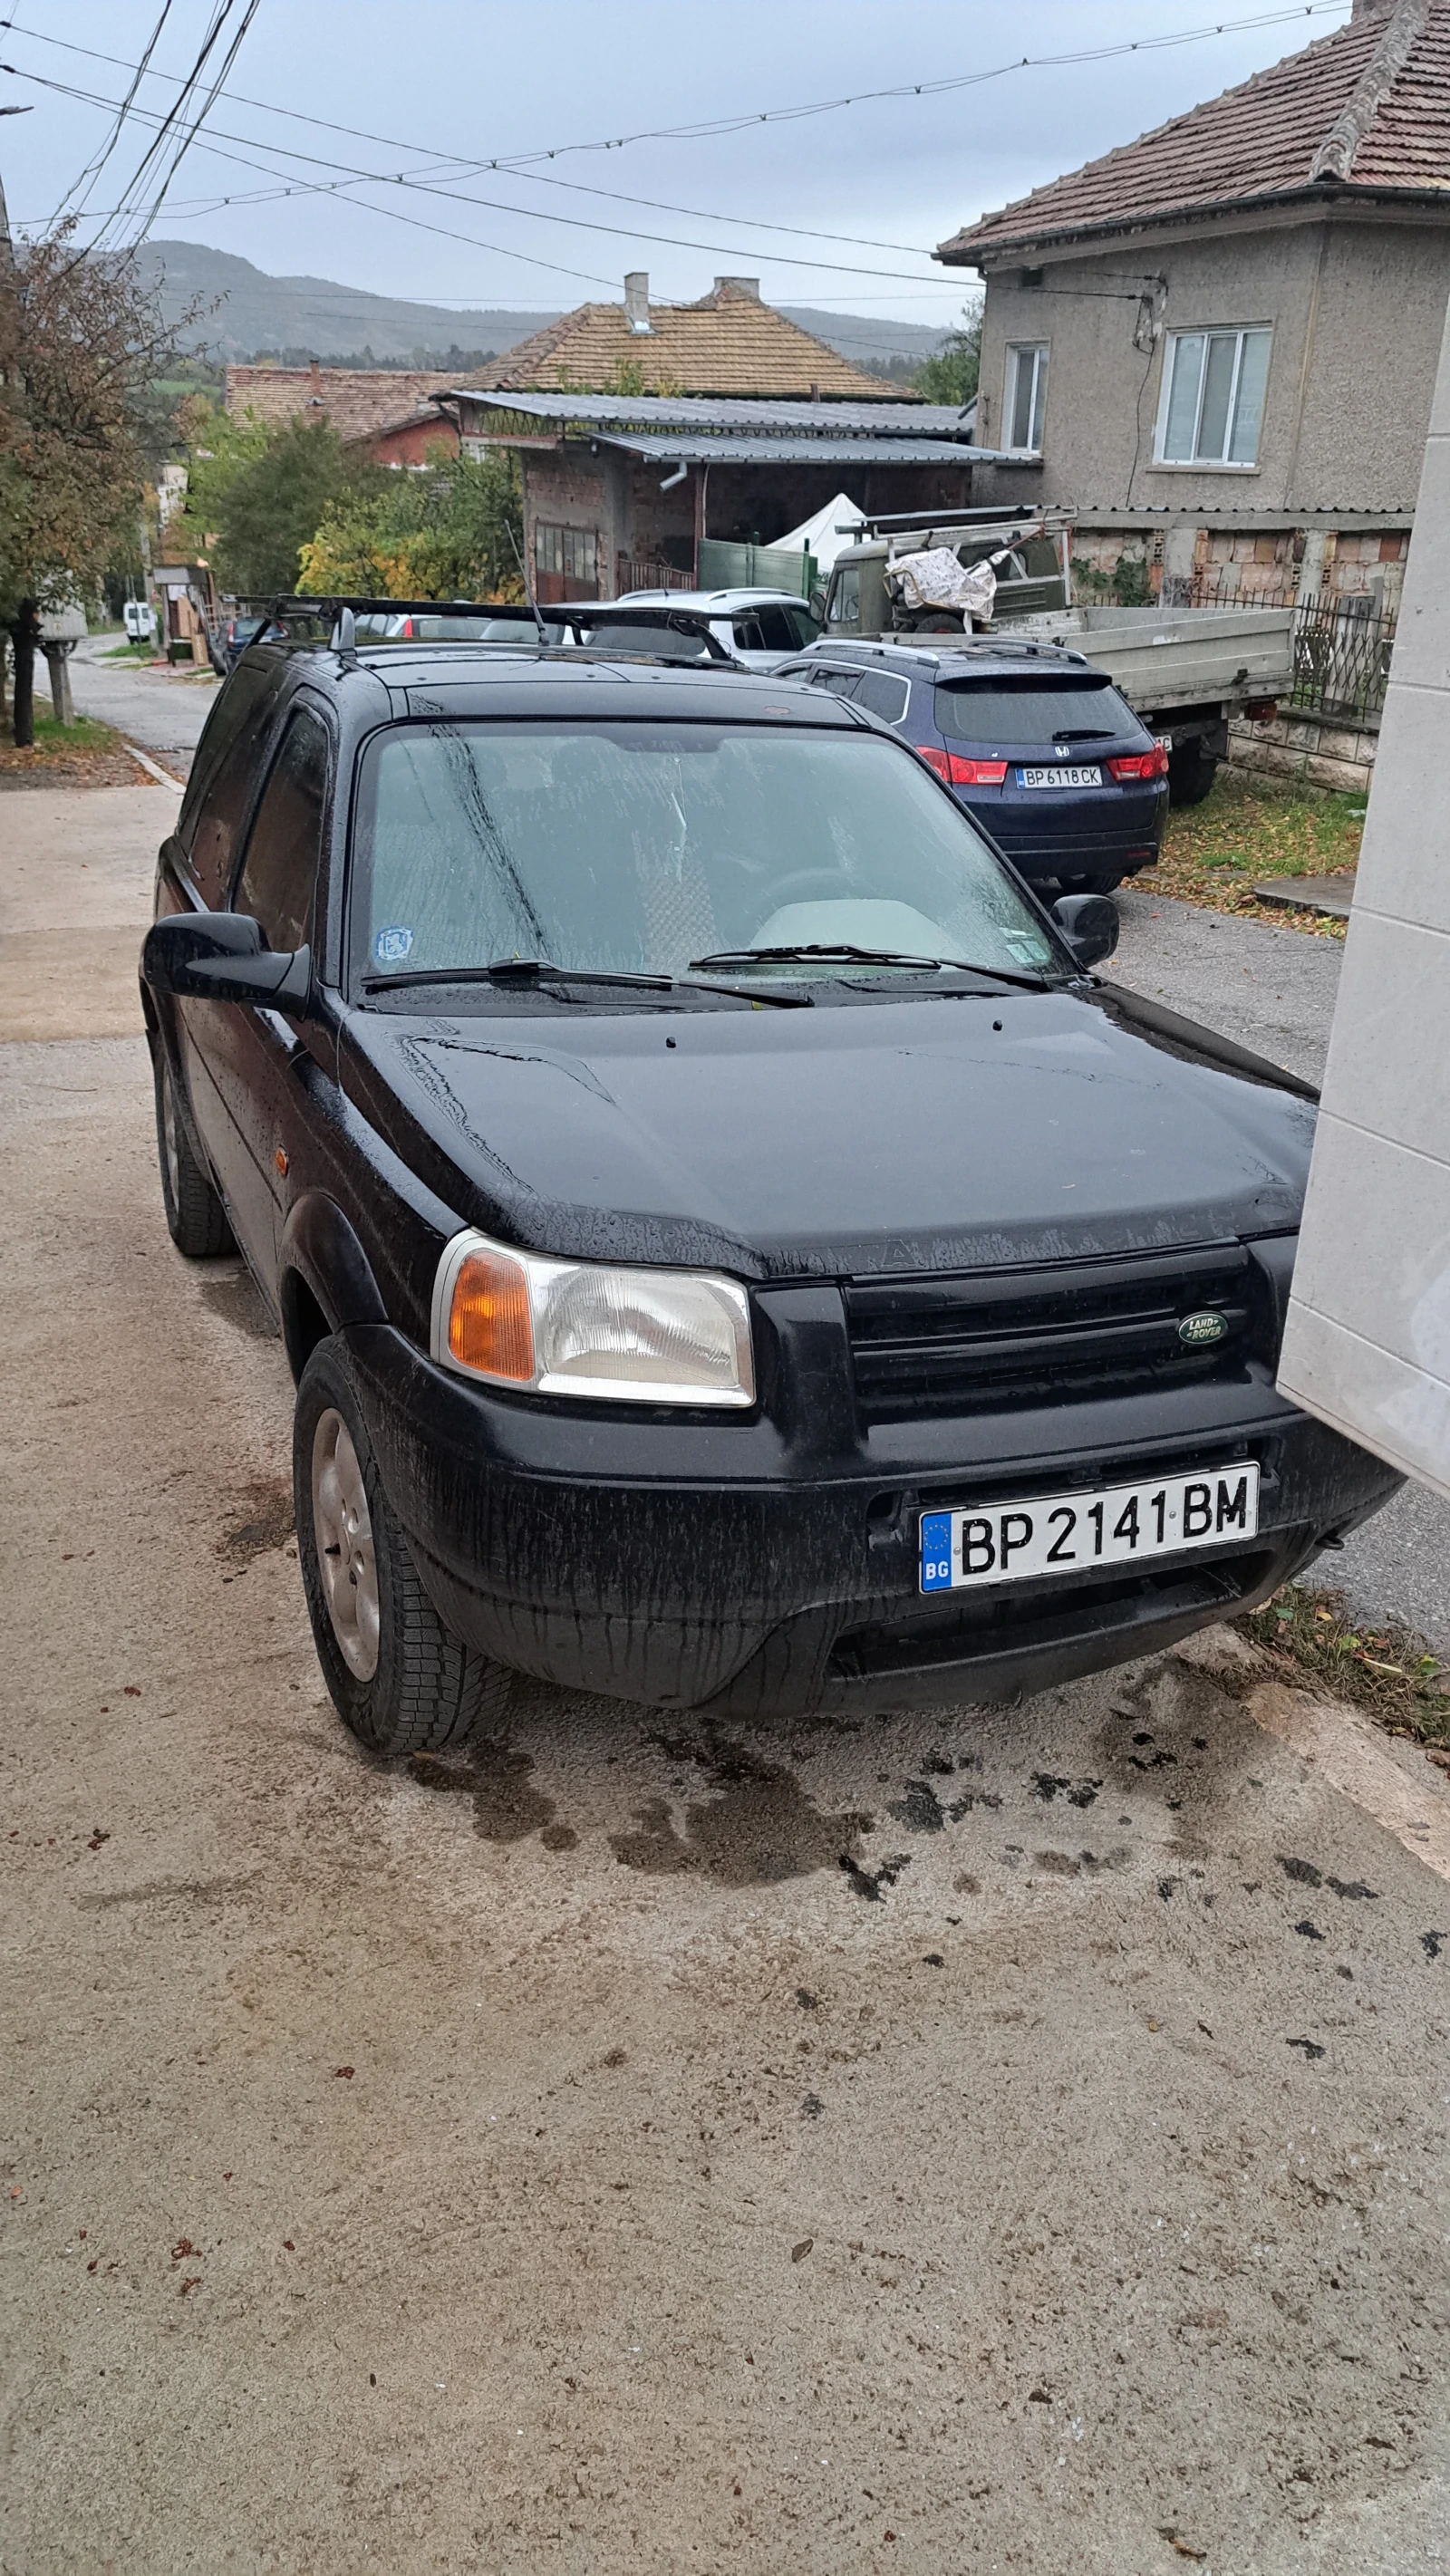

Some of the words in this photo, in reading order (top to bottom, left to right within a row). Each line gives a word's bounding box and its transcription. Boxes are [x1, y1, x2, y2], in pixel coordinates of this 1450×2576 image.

[1189, 1318, 1214, 1331] LAND
[1191, 1326, 1222, 1340] ROVER
[925, 1560, 949, 1580] BG
